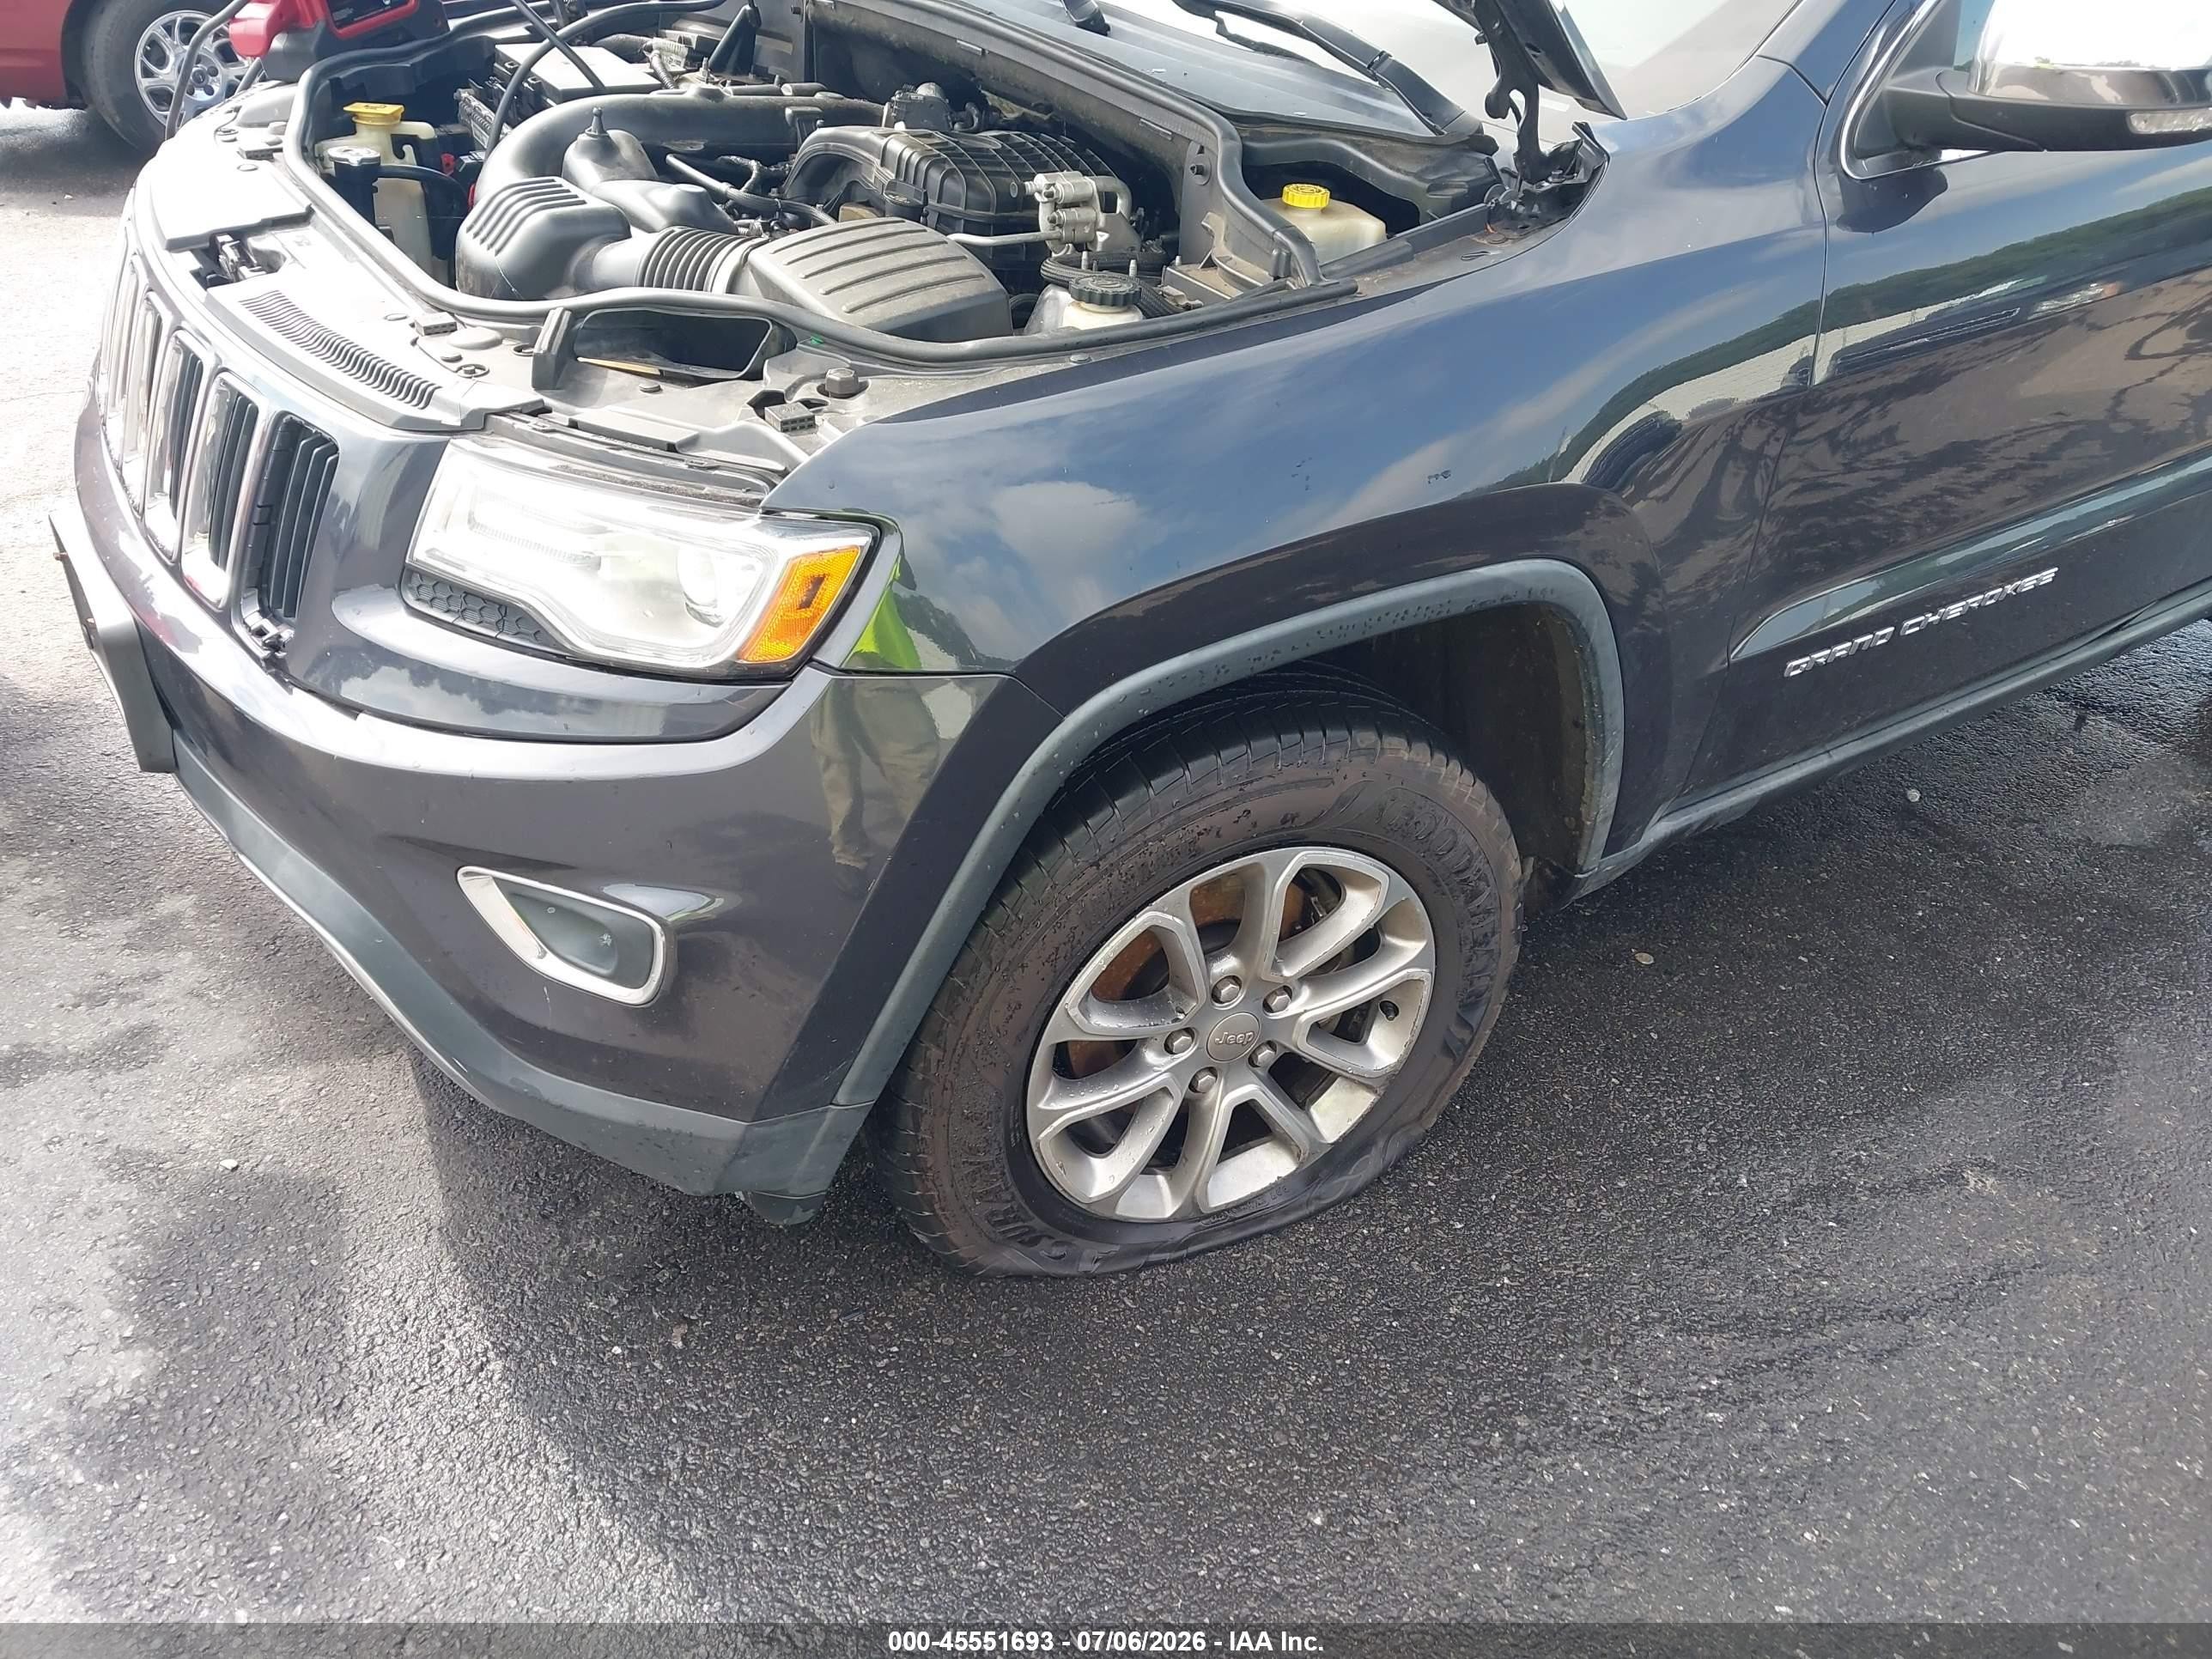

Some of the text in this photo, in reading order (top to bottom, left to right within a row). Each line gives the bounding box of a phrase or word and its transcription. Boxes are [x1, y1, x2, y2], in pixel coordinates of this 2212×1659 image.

[1784, 566, 2059, 678] GRAND CHEROKEE
[1214, 1031, 1255, 1047] Jeep
